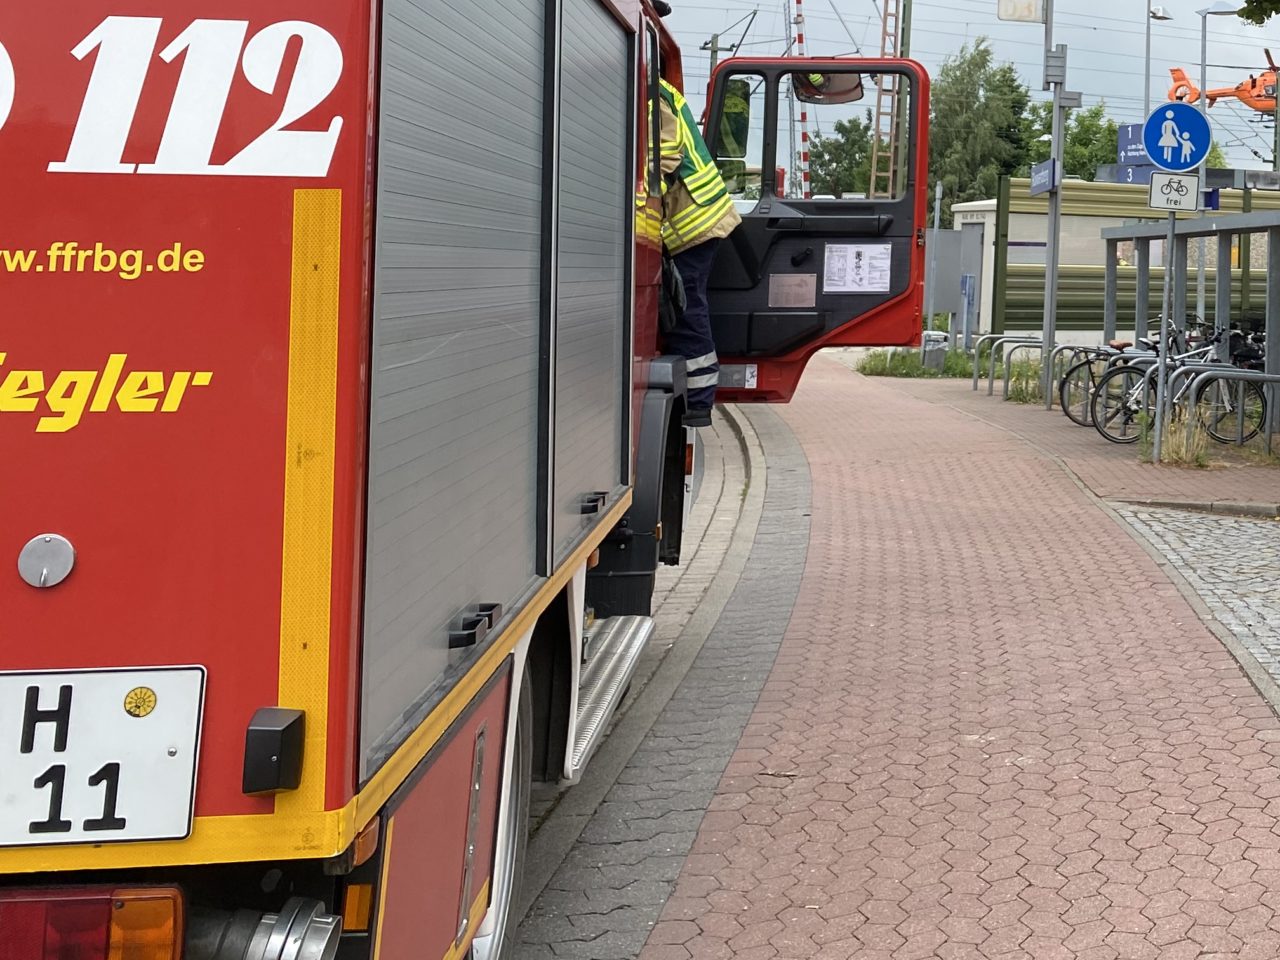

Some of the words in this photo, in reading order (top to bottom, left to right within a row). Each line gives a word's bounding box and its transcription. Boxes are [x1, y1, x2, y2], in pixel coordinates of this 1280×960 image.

[46, 15, 344, 178] 112
[1127, 168, 1133, 182] 3
[1166, 197, 1181, 206] frei
[20, 684, 73, 754] H
[29, 762, 126, 834] 11
